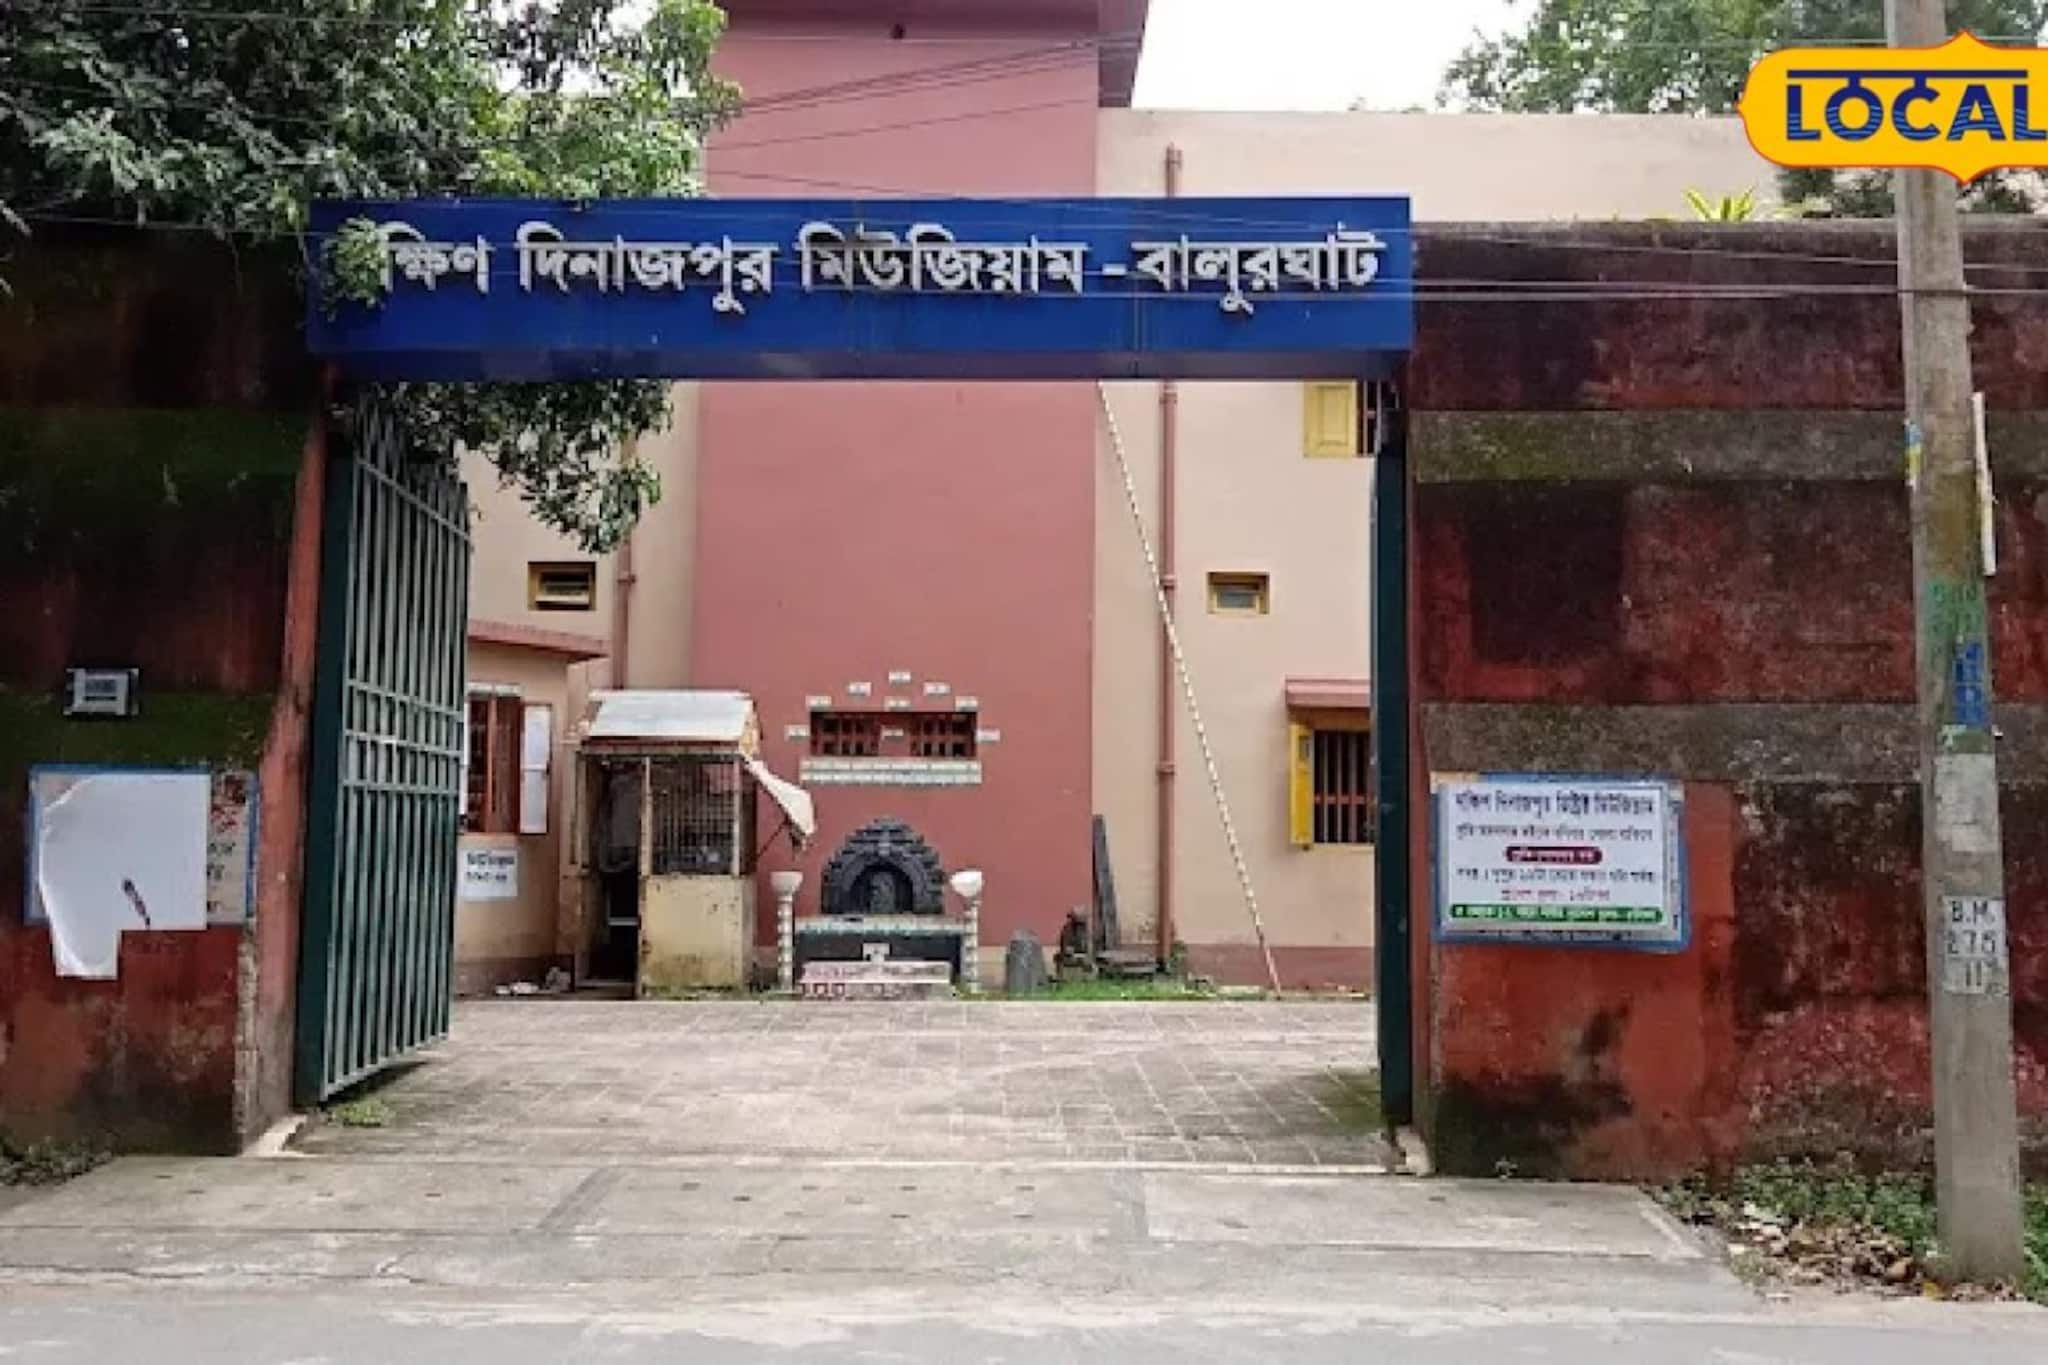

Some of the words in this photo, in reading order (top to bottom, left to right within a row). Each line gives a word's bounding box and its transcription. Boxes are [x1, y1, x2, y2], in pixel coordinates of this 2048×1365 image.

[376, 220, 496, 294] ক্ষিণ
[513, 221, 779, 315] দিনাজপুর
[796, 220, 1089, 293] মিউজিয়াম
[1131, 221, 1387, 314] বালুরঘাট
